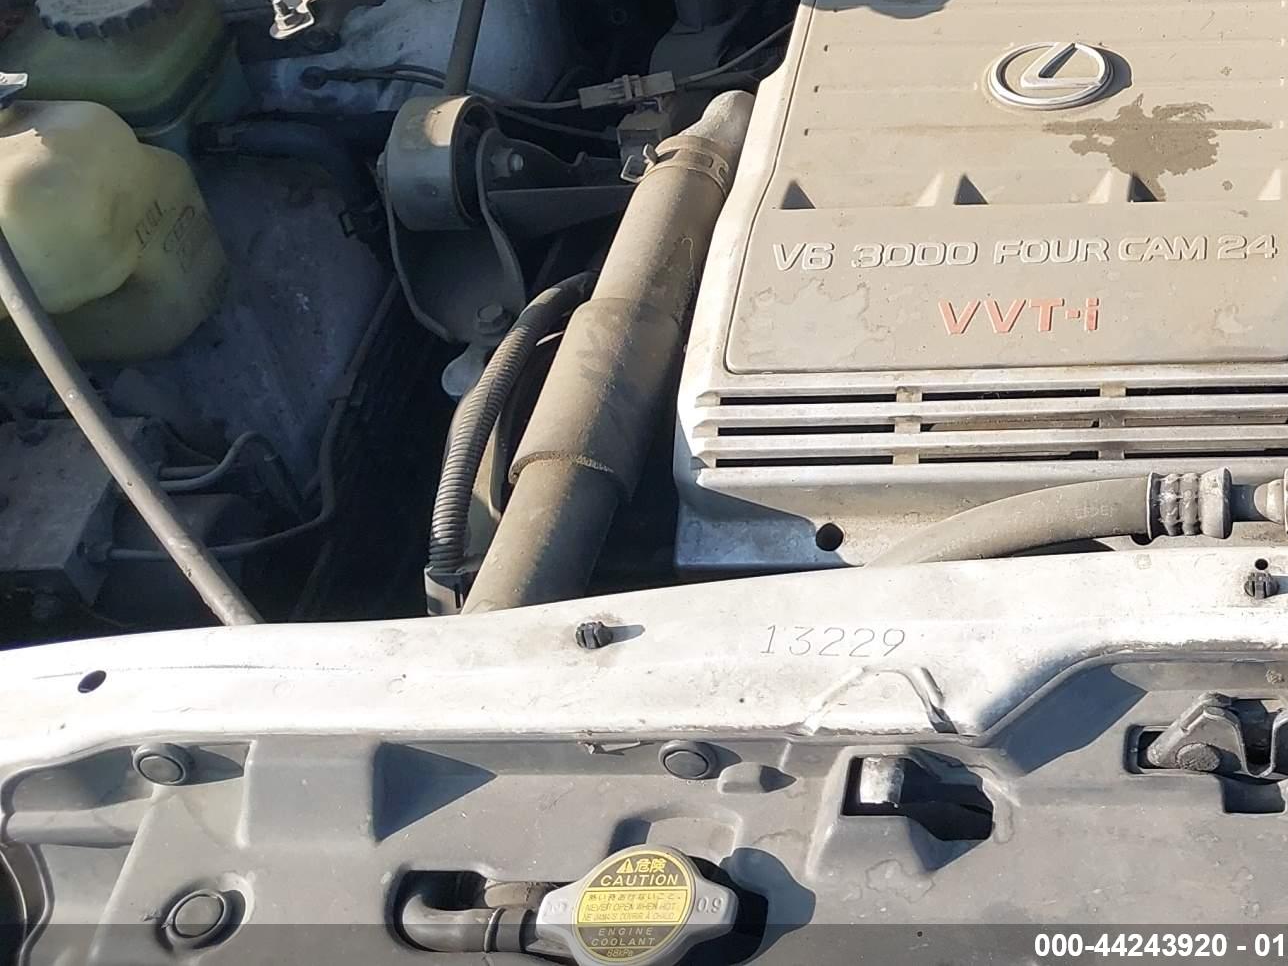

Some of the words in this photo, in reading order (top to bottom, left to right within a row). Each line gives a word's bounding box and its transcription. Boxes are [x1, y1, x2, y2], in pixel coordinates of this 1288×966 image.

[772, 242, 836, 272] V6
[851, 241, 979, 269] 3000
[993, 237, 1110, 265] FOUR
[1118, 235, 1208, 262] CAM
[1217, 234, 1279, 261] 24
[760, 624, 906, 657] 13229
[635, 857, 667, 874] 危険
[600, 873, 679, 887] CAUTION
[696, 897, 725, 915] 0.9
[598, 927, 654, 936] ENGINE
[591, 937, 656, 947] COOLANT
